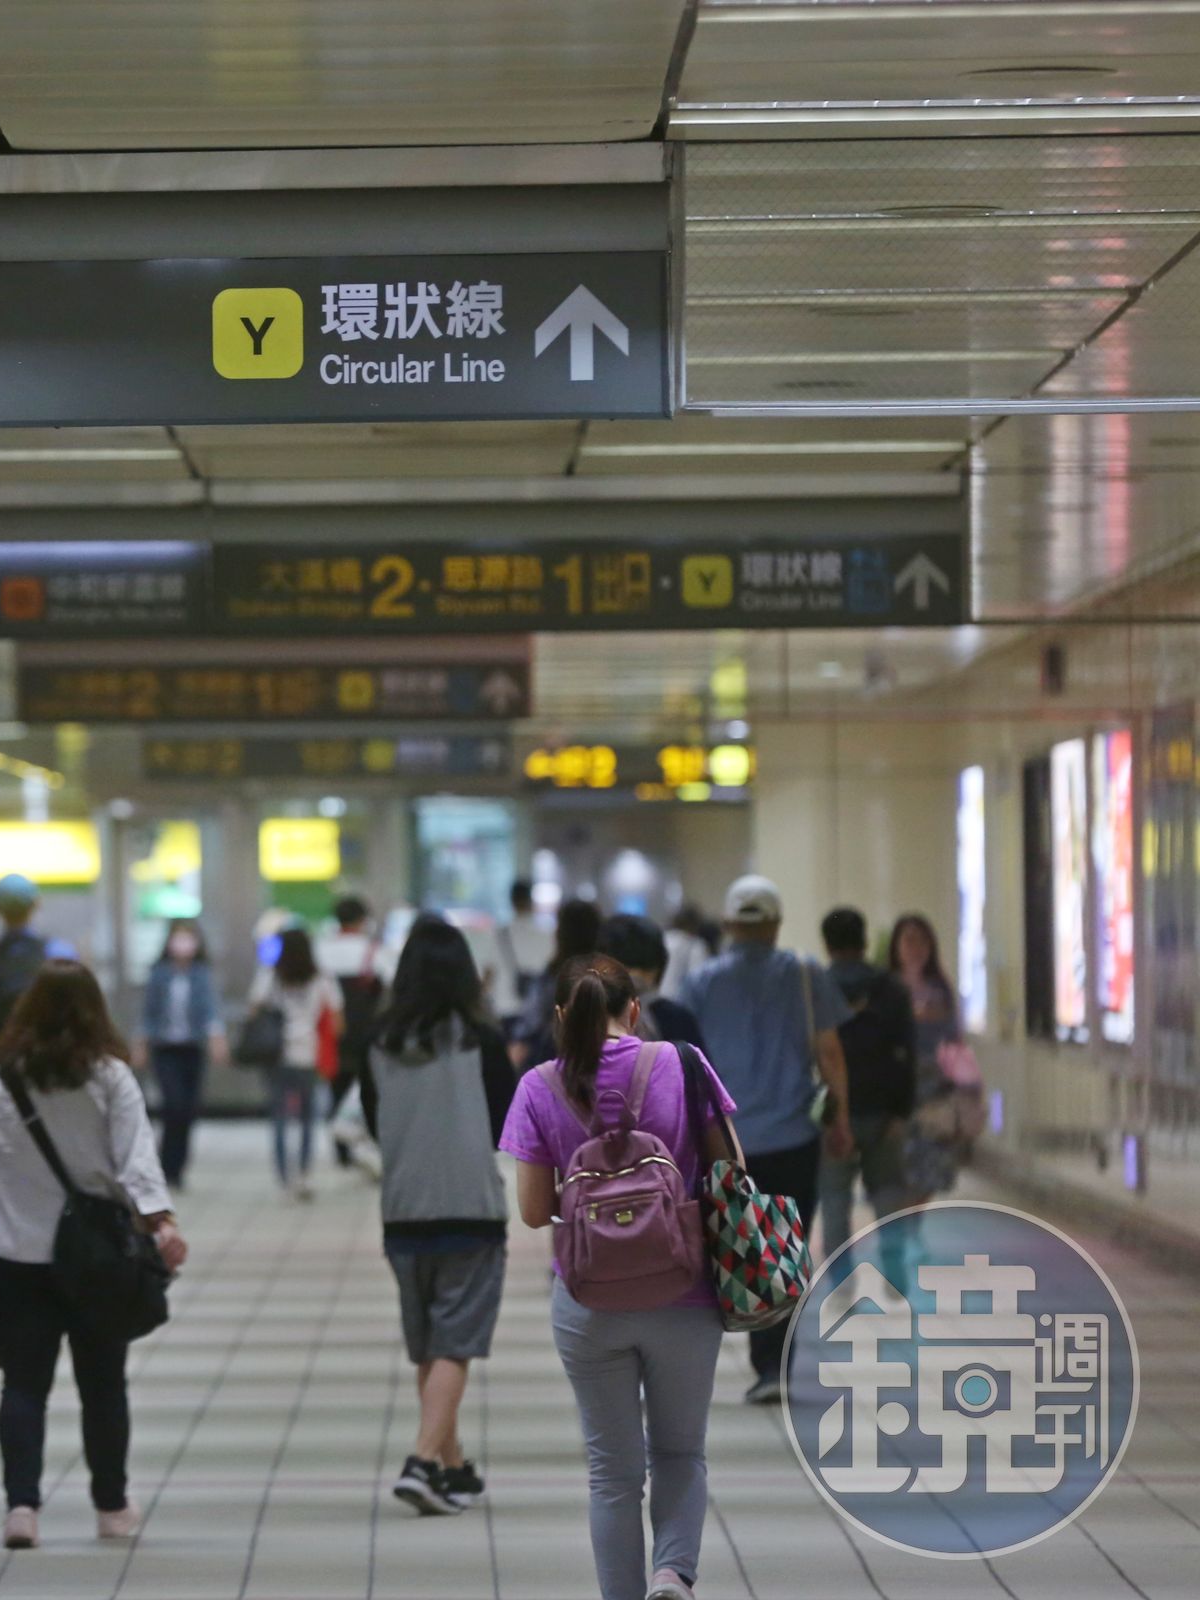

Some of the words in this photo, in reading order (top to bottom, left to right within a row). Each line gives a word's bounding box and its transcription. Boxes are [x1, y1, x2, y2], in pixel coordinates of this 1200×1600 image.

[240, 317, 275, 355] Y
[320, 280, 506, 342] 環狀線
[319, 354, 436, 385] Circular
[444, 353, 506, 383] Line
[370, 555, 415, 618] 2
[553, 554, 582, 614] 1
